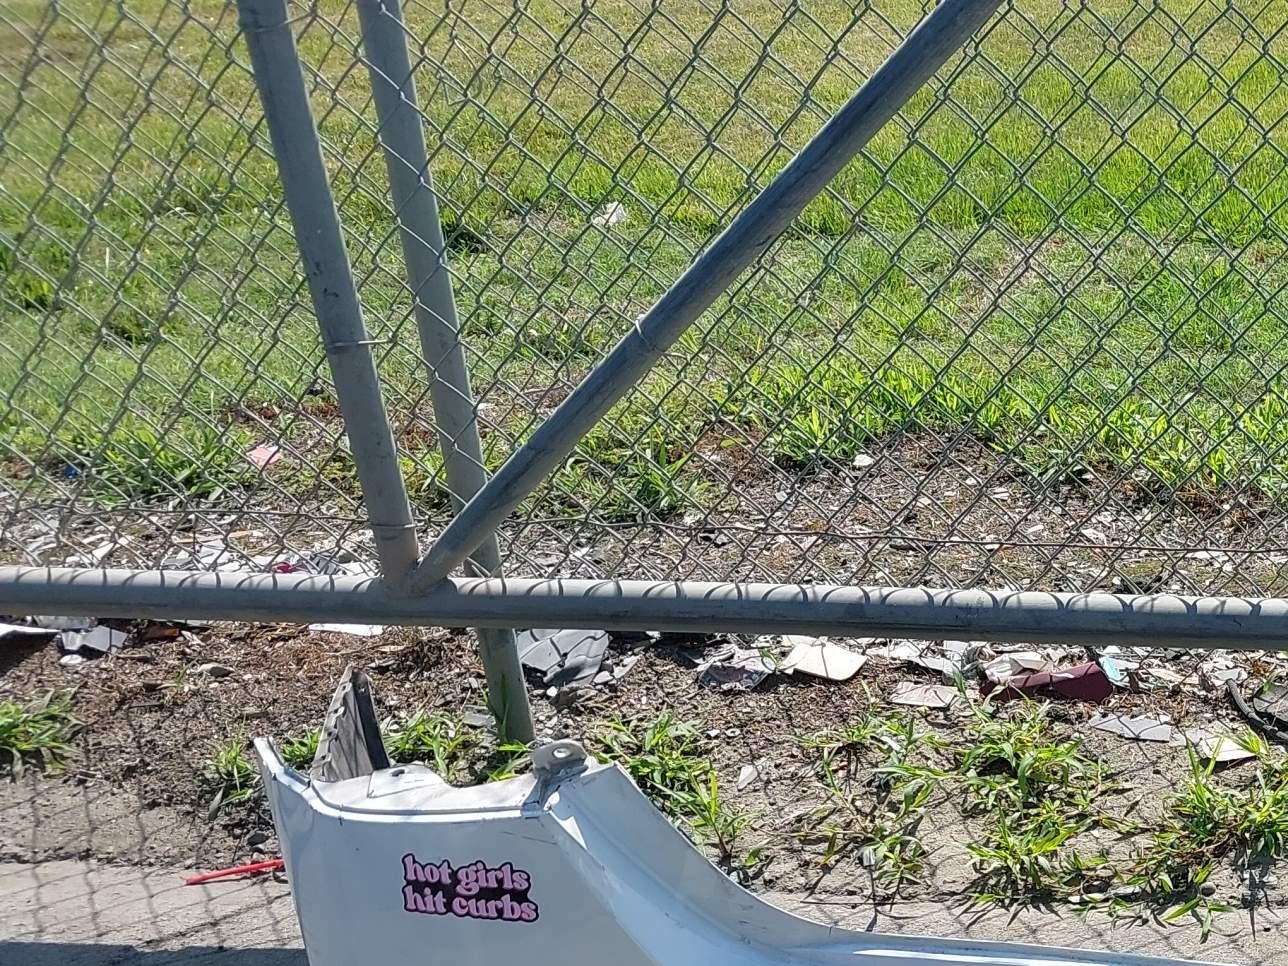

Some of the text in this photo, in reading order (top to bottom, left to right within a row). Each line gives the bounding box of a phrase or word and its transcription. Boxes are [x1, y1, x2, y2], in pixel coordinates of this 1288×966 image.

[403, 854, 529, 896] hot girls
[403, 886, 538, 921] hit curbs
